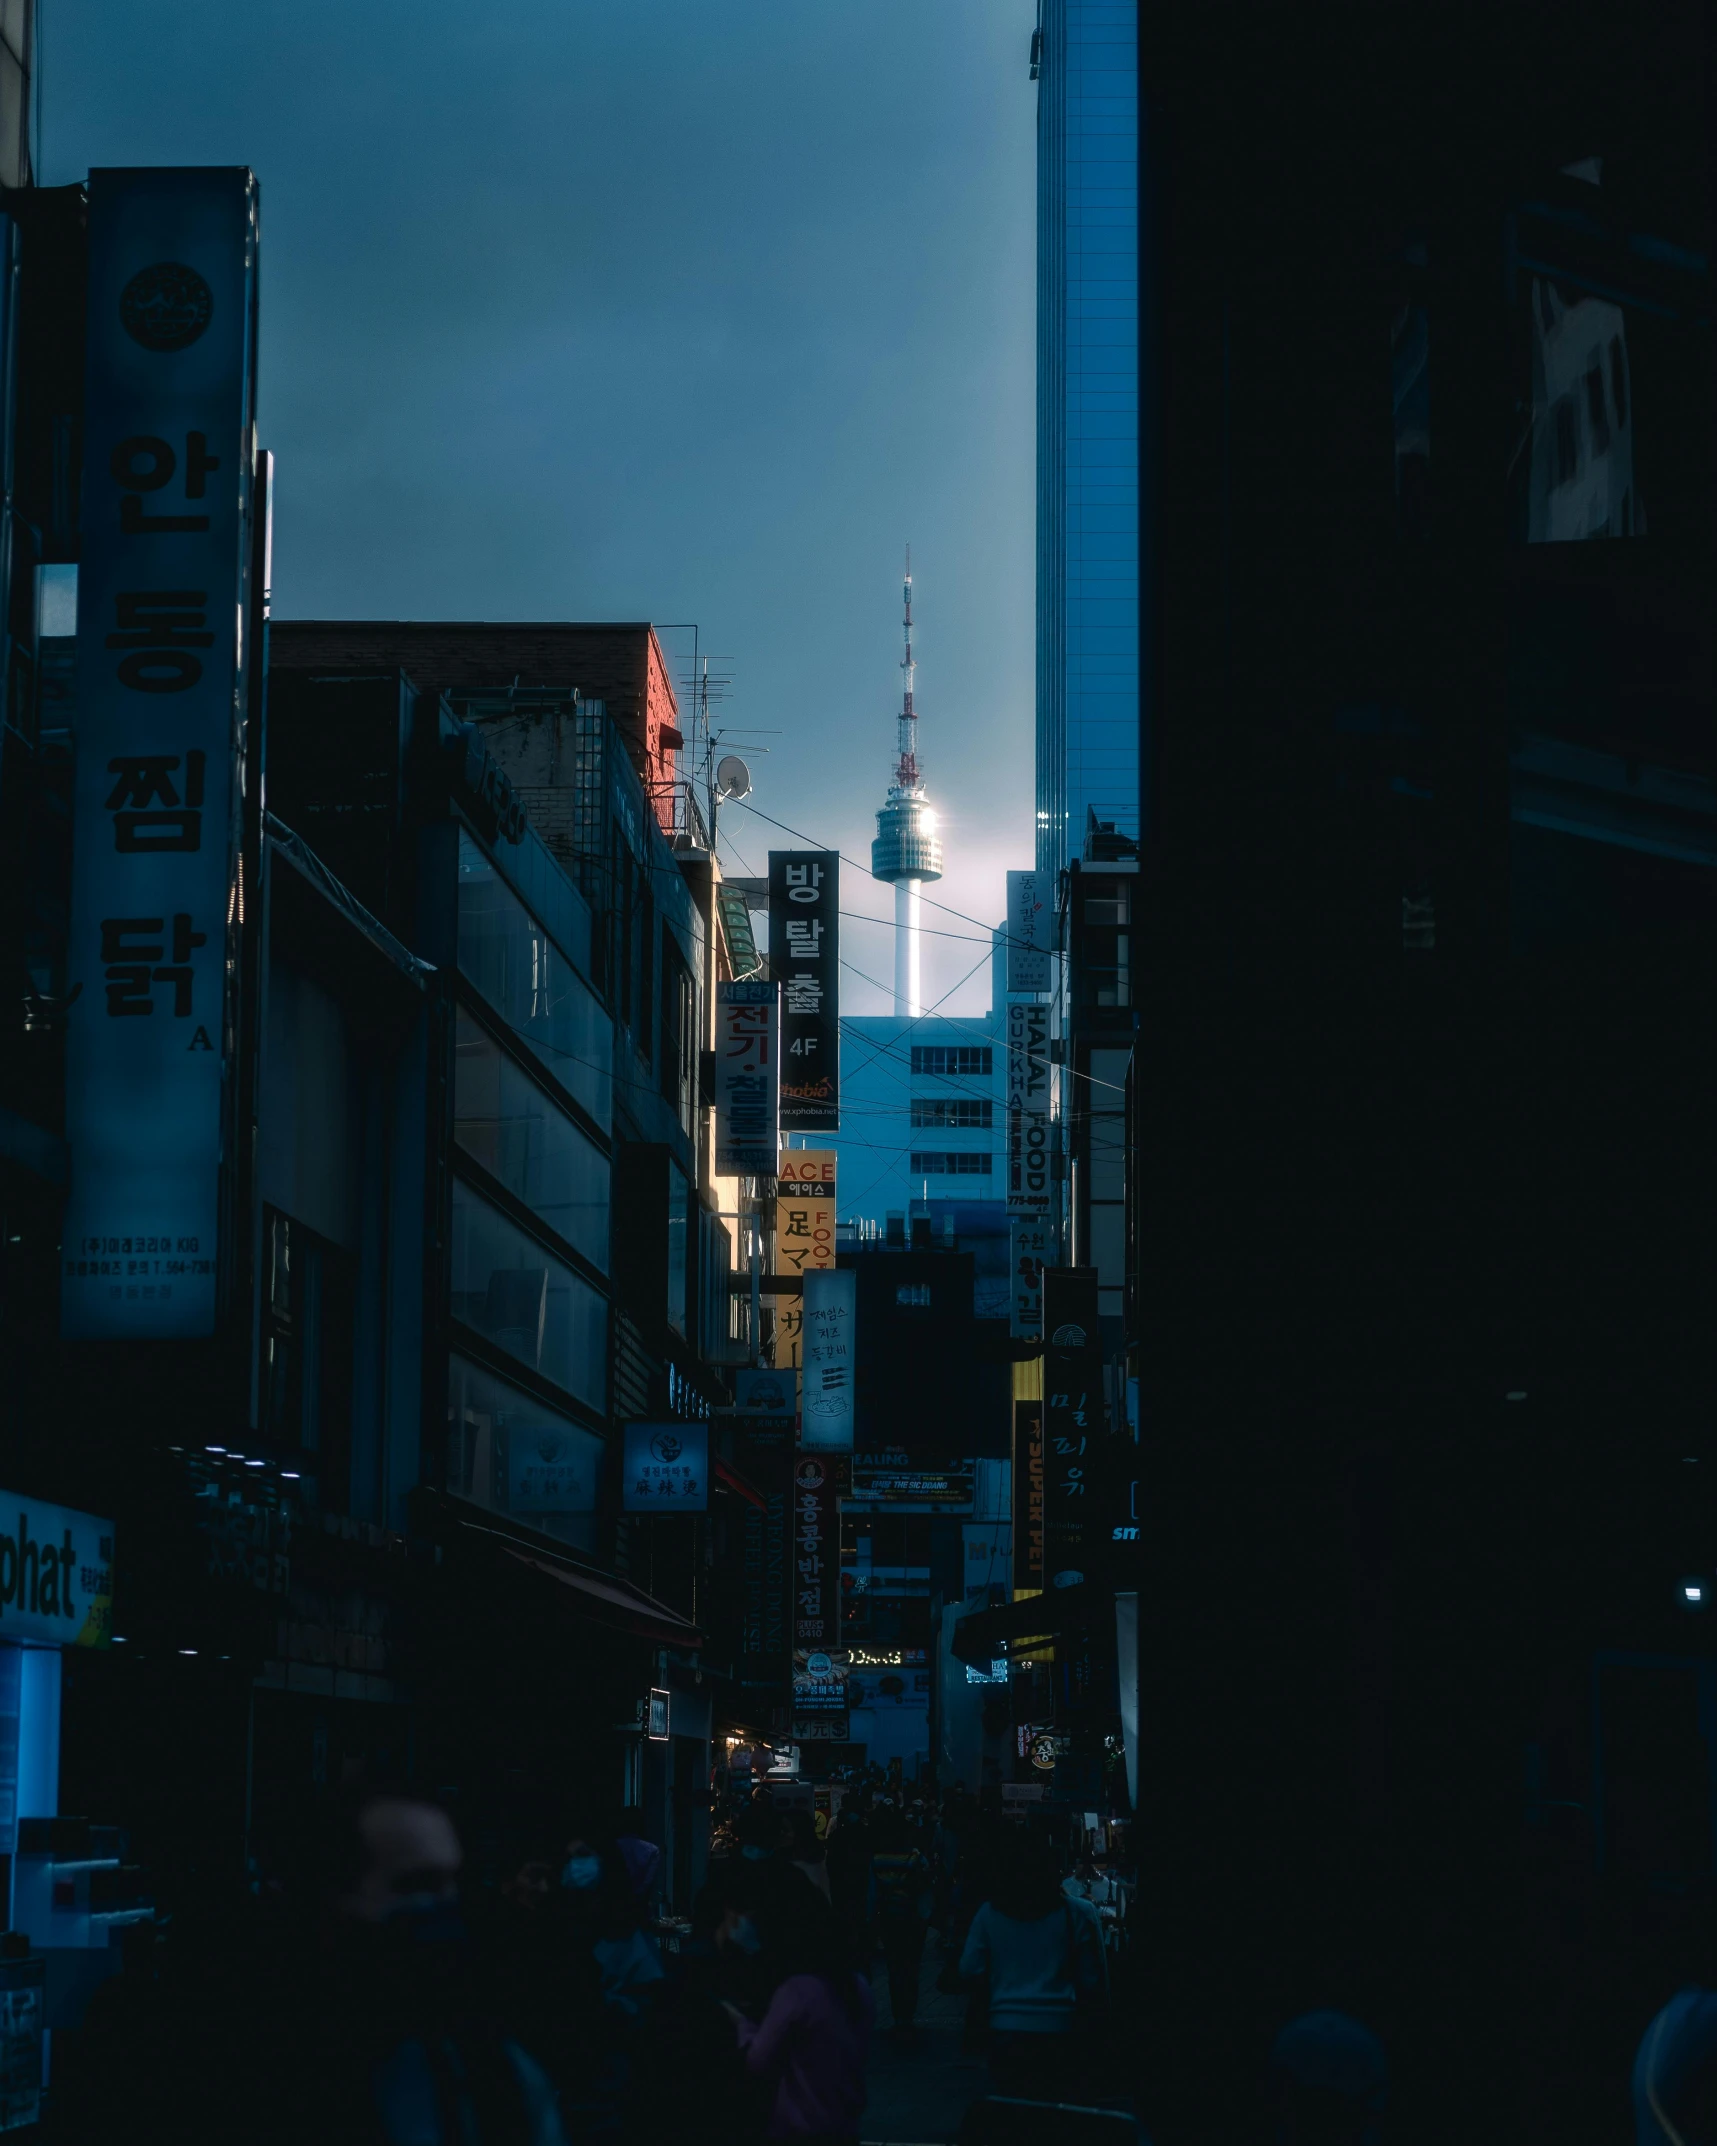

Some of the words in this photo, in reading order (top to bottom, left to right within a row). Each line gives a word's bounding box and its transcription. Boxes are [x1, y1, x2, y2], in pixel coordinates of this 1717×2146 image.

[101, 431, 220, 1017] 안동찜닭
[784, 863, 824, 1014] 방탈출
[720, 985, 776, 1000] 서울전기
[790, 1038, 818, 1056] 4F
[1027, 1006, 1045, 1097] HALAL
[1009, 1006, 1024, 1108] GURKHA
[1027, 1112, 1045, 1191] FOOD
[780, 1163, 834, 1181] ACE
[789, 1183, 824, 1196] 에이스
[1016, 1232, 1045, 1251] 수원
[809, 1306, 849, 1321] 제임스
[817, 1327, 841, 1340] 치즈
[811, 1344, 847, 1361] 등갈비
[893, 1480, 908, 1489] THE
[1028, 1441, 1043, 1522] SUPER
[744, 1505, 763, 1574] OFFEE
[796, 1493, 824, 1616] 홍콩반점
[798, 1630, 823, 1638] 0410
[813, 1721, 827, 1737] 元
